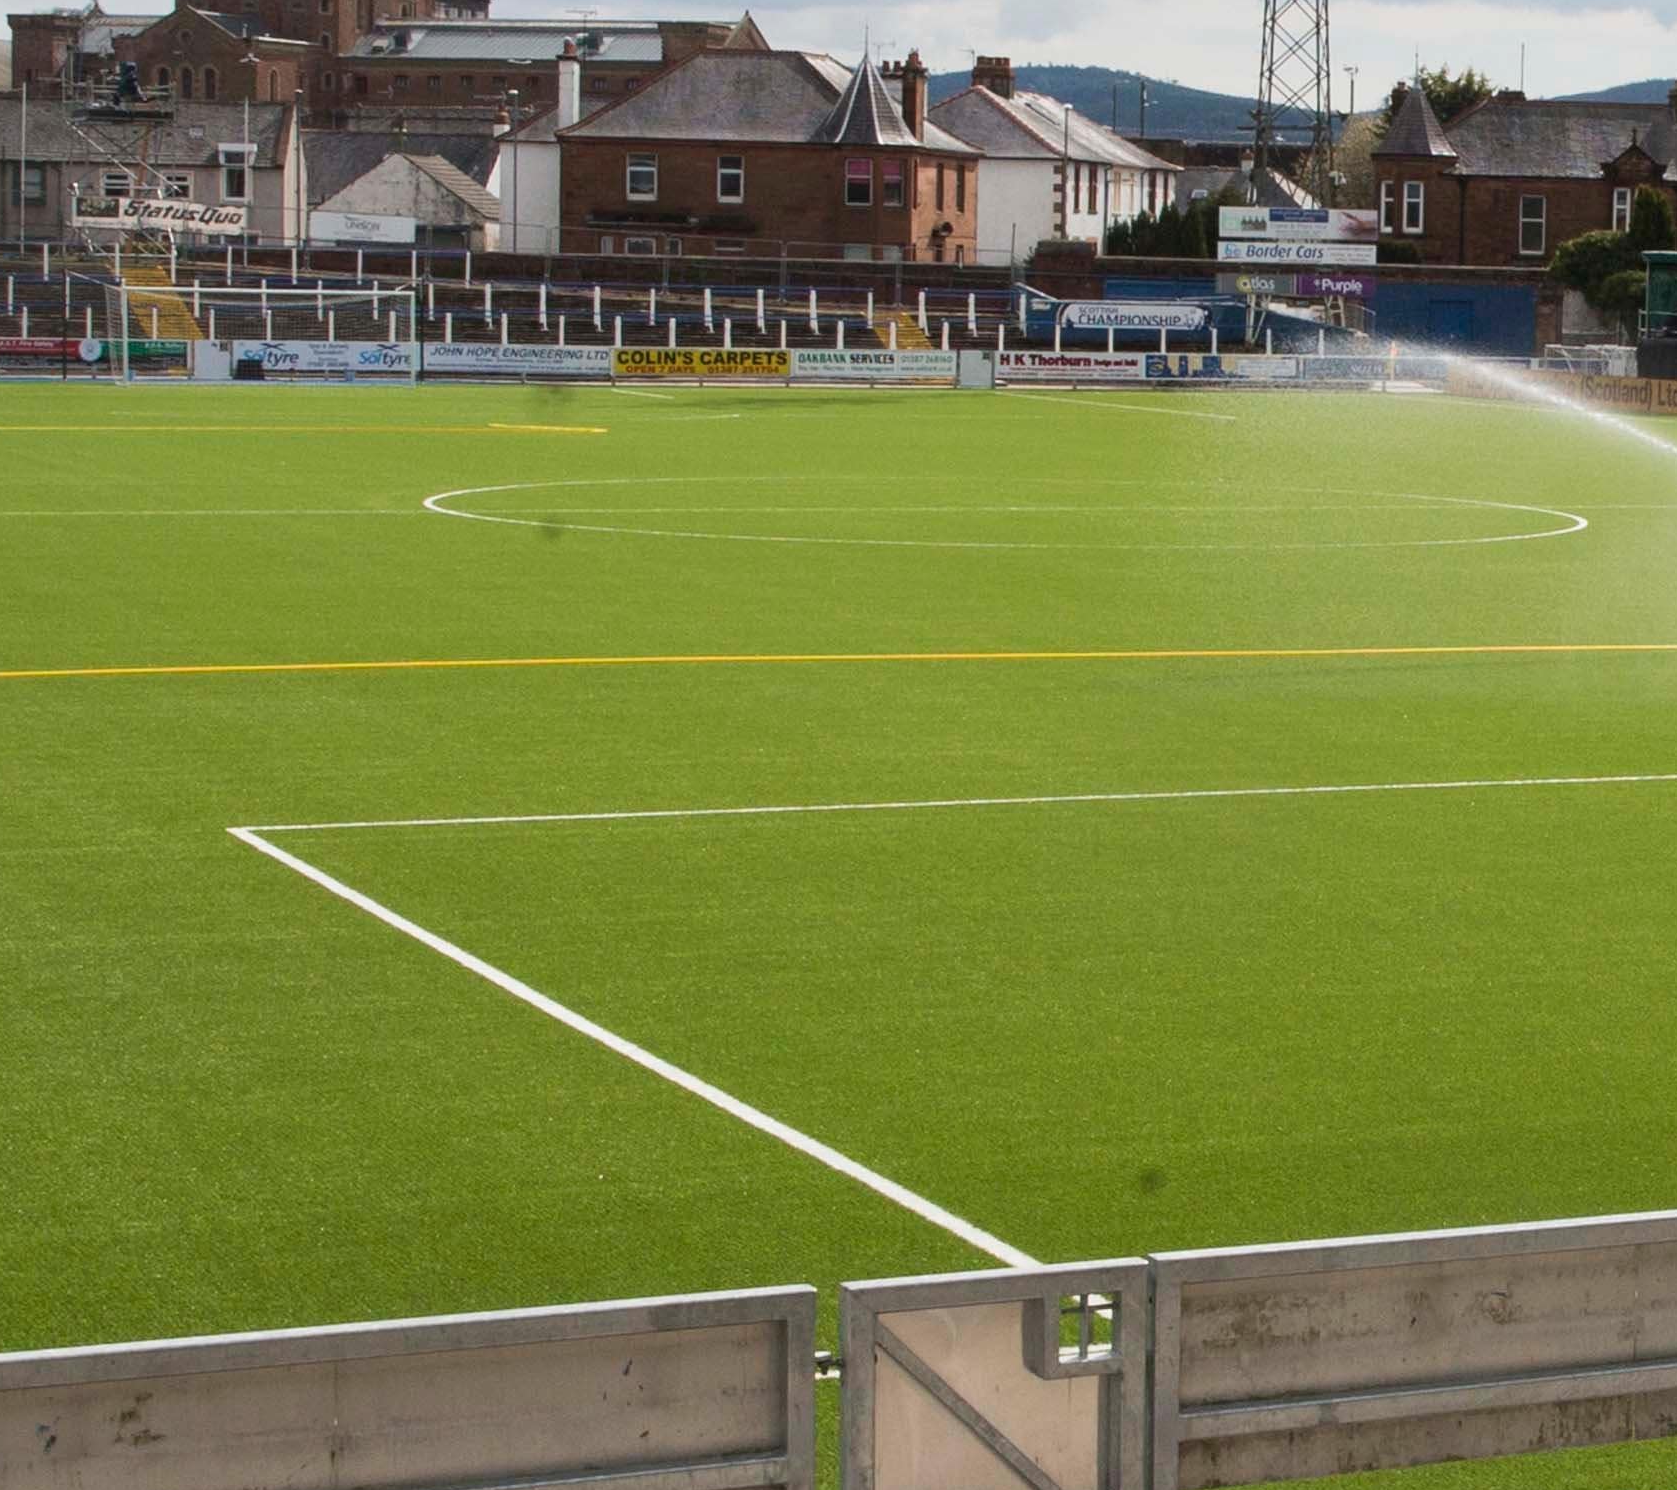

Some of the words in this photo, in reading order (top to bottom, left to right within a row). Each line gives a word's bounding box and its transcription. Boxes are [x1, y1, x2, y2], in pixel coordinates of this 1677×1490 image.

[1246, 244, 1292, 258] Border
[1296, 245, 1323, 258] Cars
[1322, 279, 1363, 294] Purple
[1078, 315, 1181, 326] CHAMPIONSHIP
[430, 346, 463, 357] JOHN
[466, 347, 499, 358] HOPE
[502, 347, 583, 360] ENGINEERING
[586, 350, 609, 360] LTD
[617, 350, 694, 365] COLIN'S
[700, 351, 788, 365] CARPETS
[798, 353, 847, 364] OAKBANK
[850, 353, 895, 364] SERVICES
[1000, 354, 1010, 366] H
[1015, 354, 1025, 366] K
[1028, 354, 1092, 366] Thorburn
[625, 365, 656, 374] OPEN
[667, 366, 695, 374] DAYS
